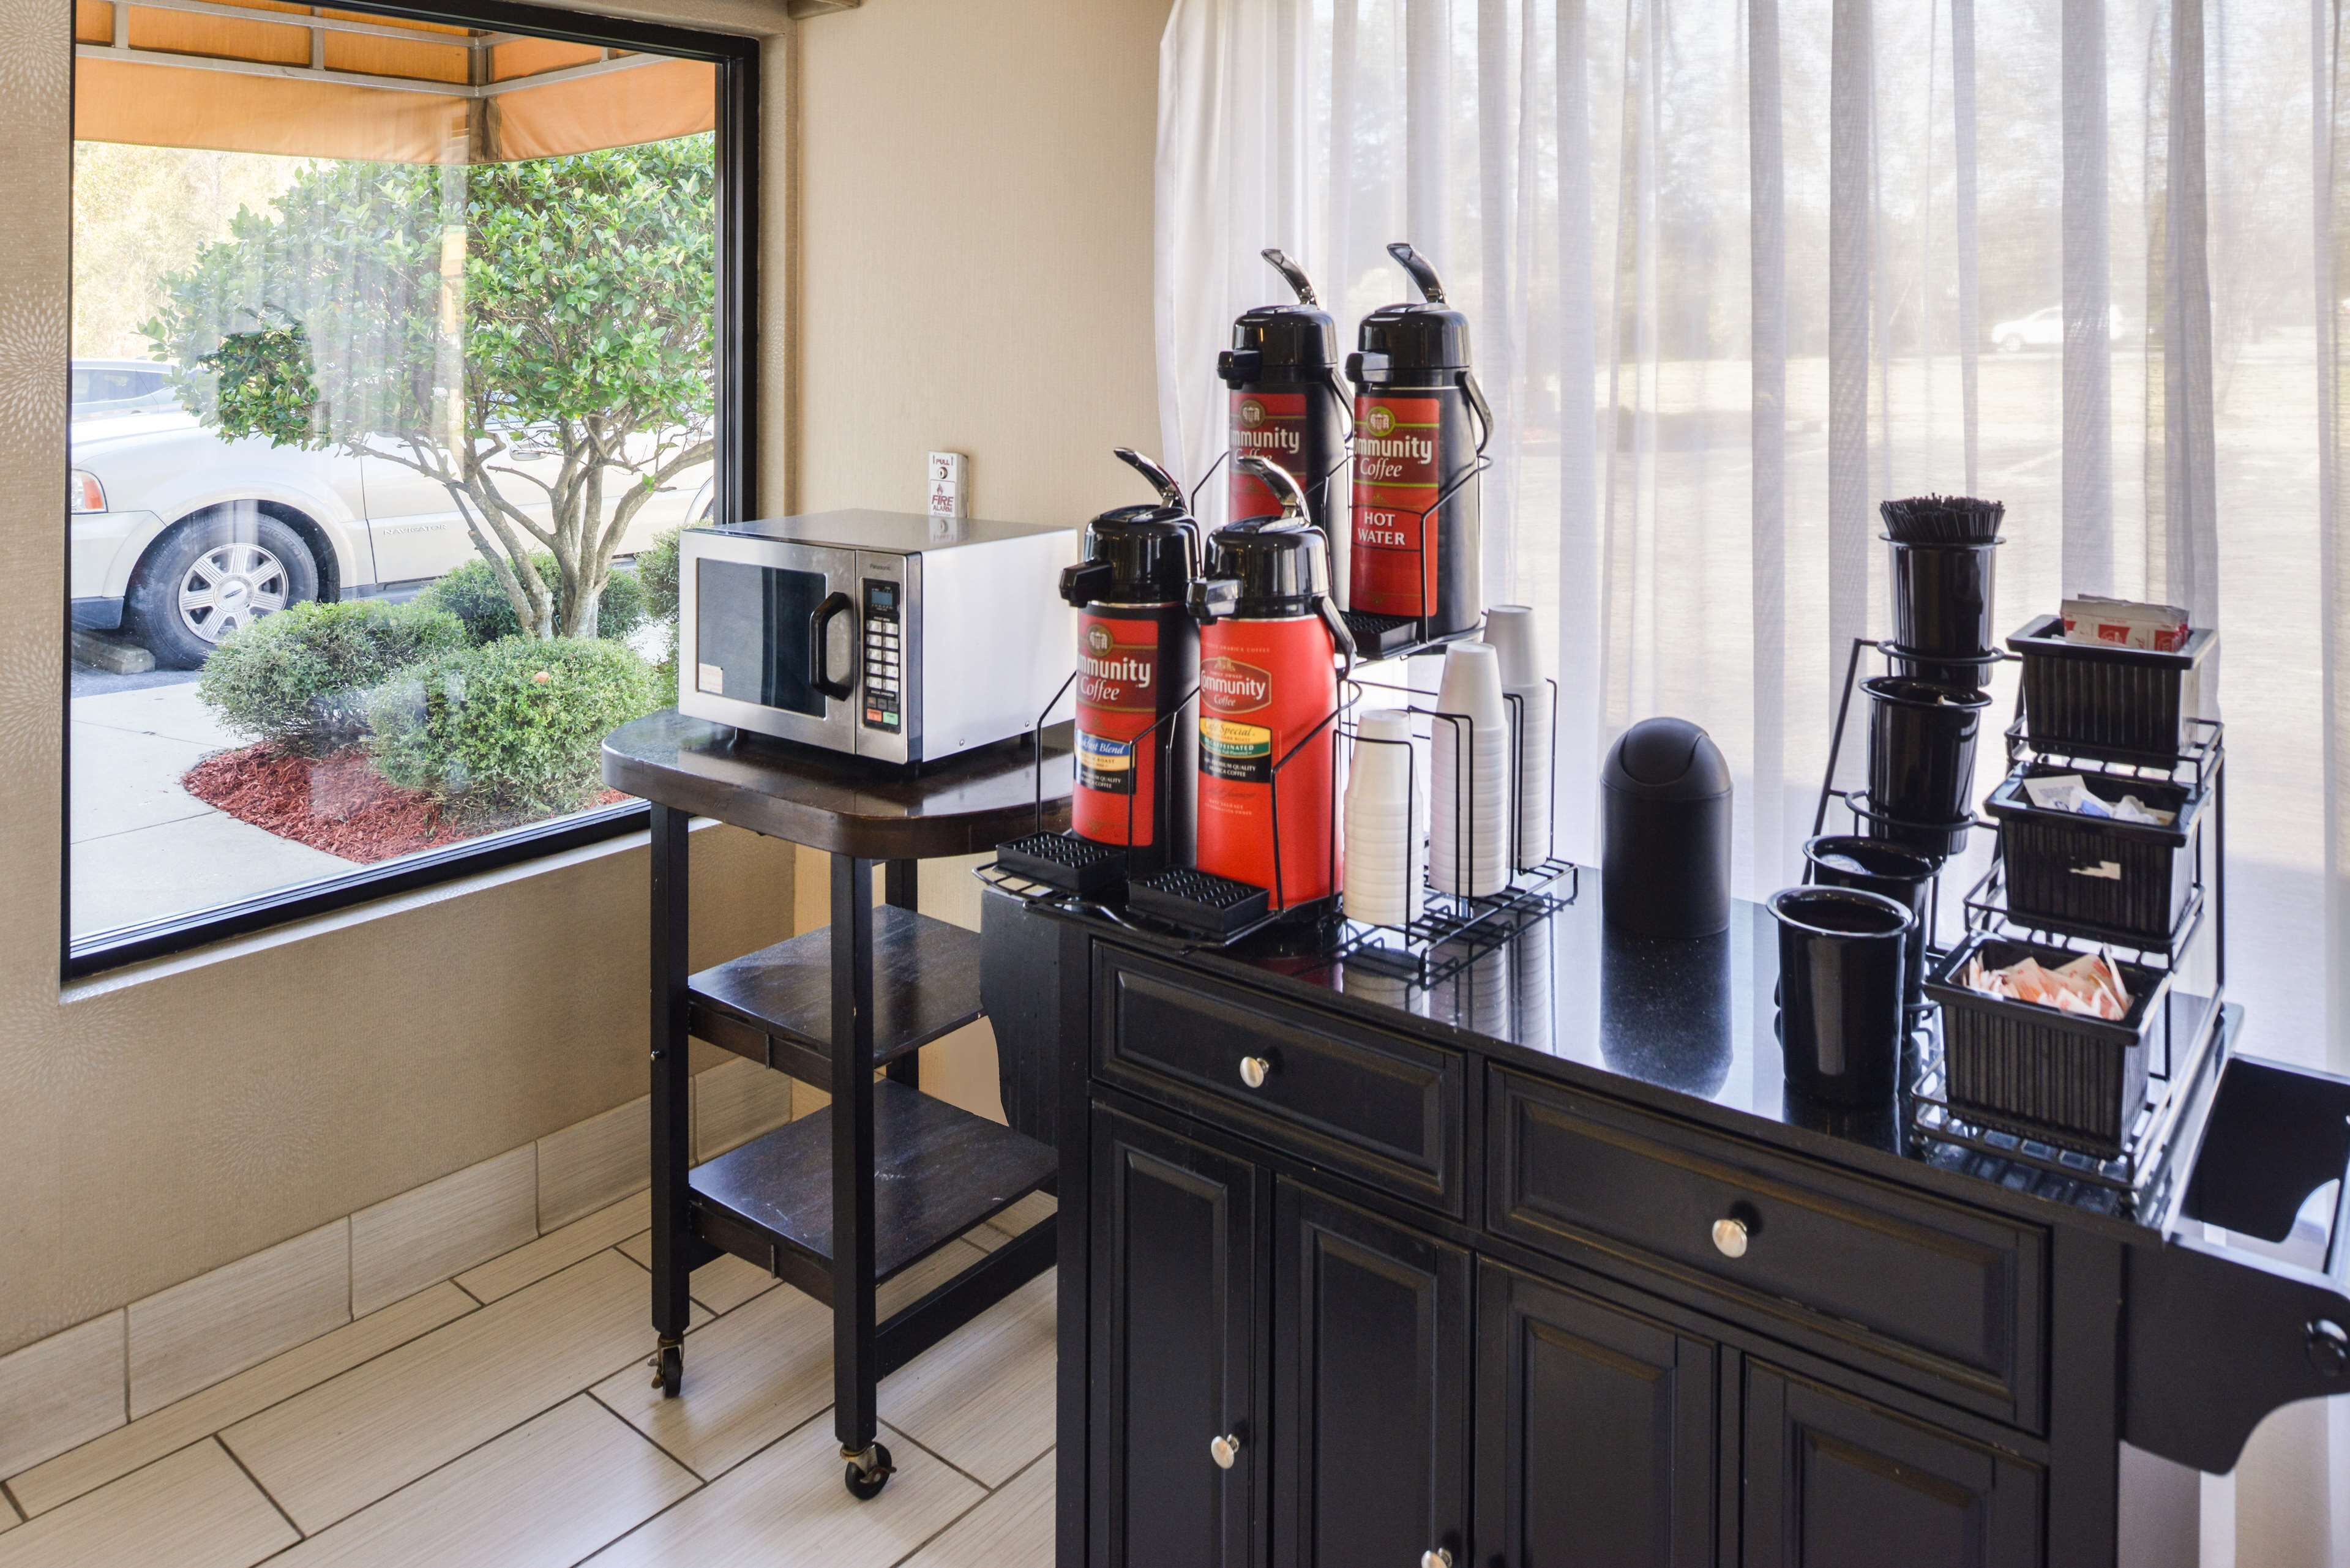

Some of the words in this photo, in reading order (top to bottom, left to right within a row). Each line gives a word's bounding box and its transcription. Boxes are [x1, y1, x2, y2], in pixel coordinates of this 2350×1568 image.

[1353, 432, 1432, 465] ommunity
[1360, 457, 1402, 480] Coffee
[932, 495, 954, 506] FIRE
[1363, 511, 1396, 527] HOT
[383, 523, 447, 536] NAVIGATOR
[1357, 528, 1405, 545] WATER
[1080, 676, 1120, 701] Coffee
[1200, 670, 1266, 701] Community
[1214, 694, 1236, 707] Coffee
[1221, 724, 1252, 737] Special
[1099, 742, 1125, 754] Blend
